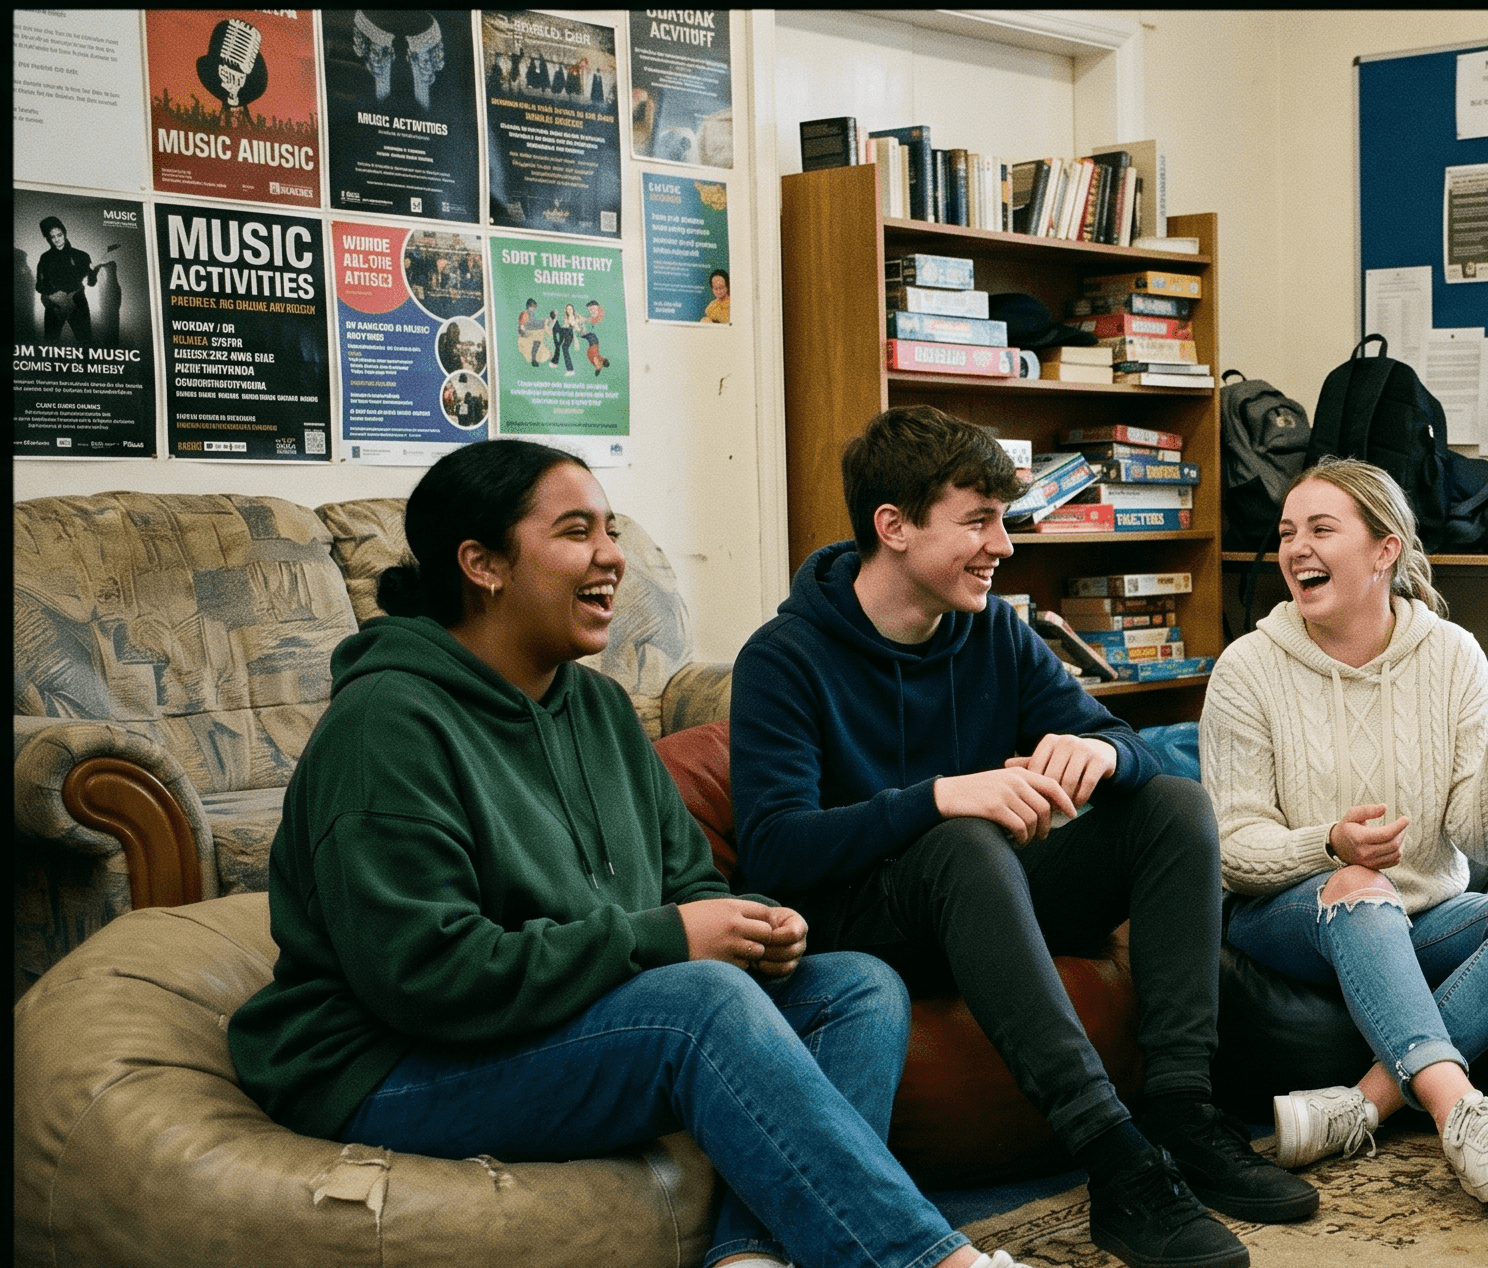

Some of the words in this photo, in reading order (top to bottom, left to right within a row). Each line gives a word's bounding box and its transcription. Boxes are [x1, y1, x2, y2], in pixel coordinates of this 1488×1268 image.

[158, 128, 232, 160] MUSIC
[103, 210, 137, 221] MUSIC
[167, 214, 313, 269] MUSIC
[169, 263, 315, 299] ACTIVITIES
[88, 347, 141, 362] MUSIC
